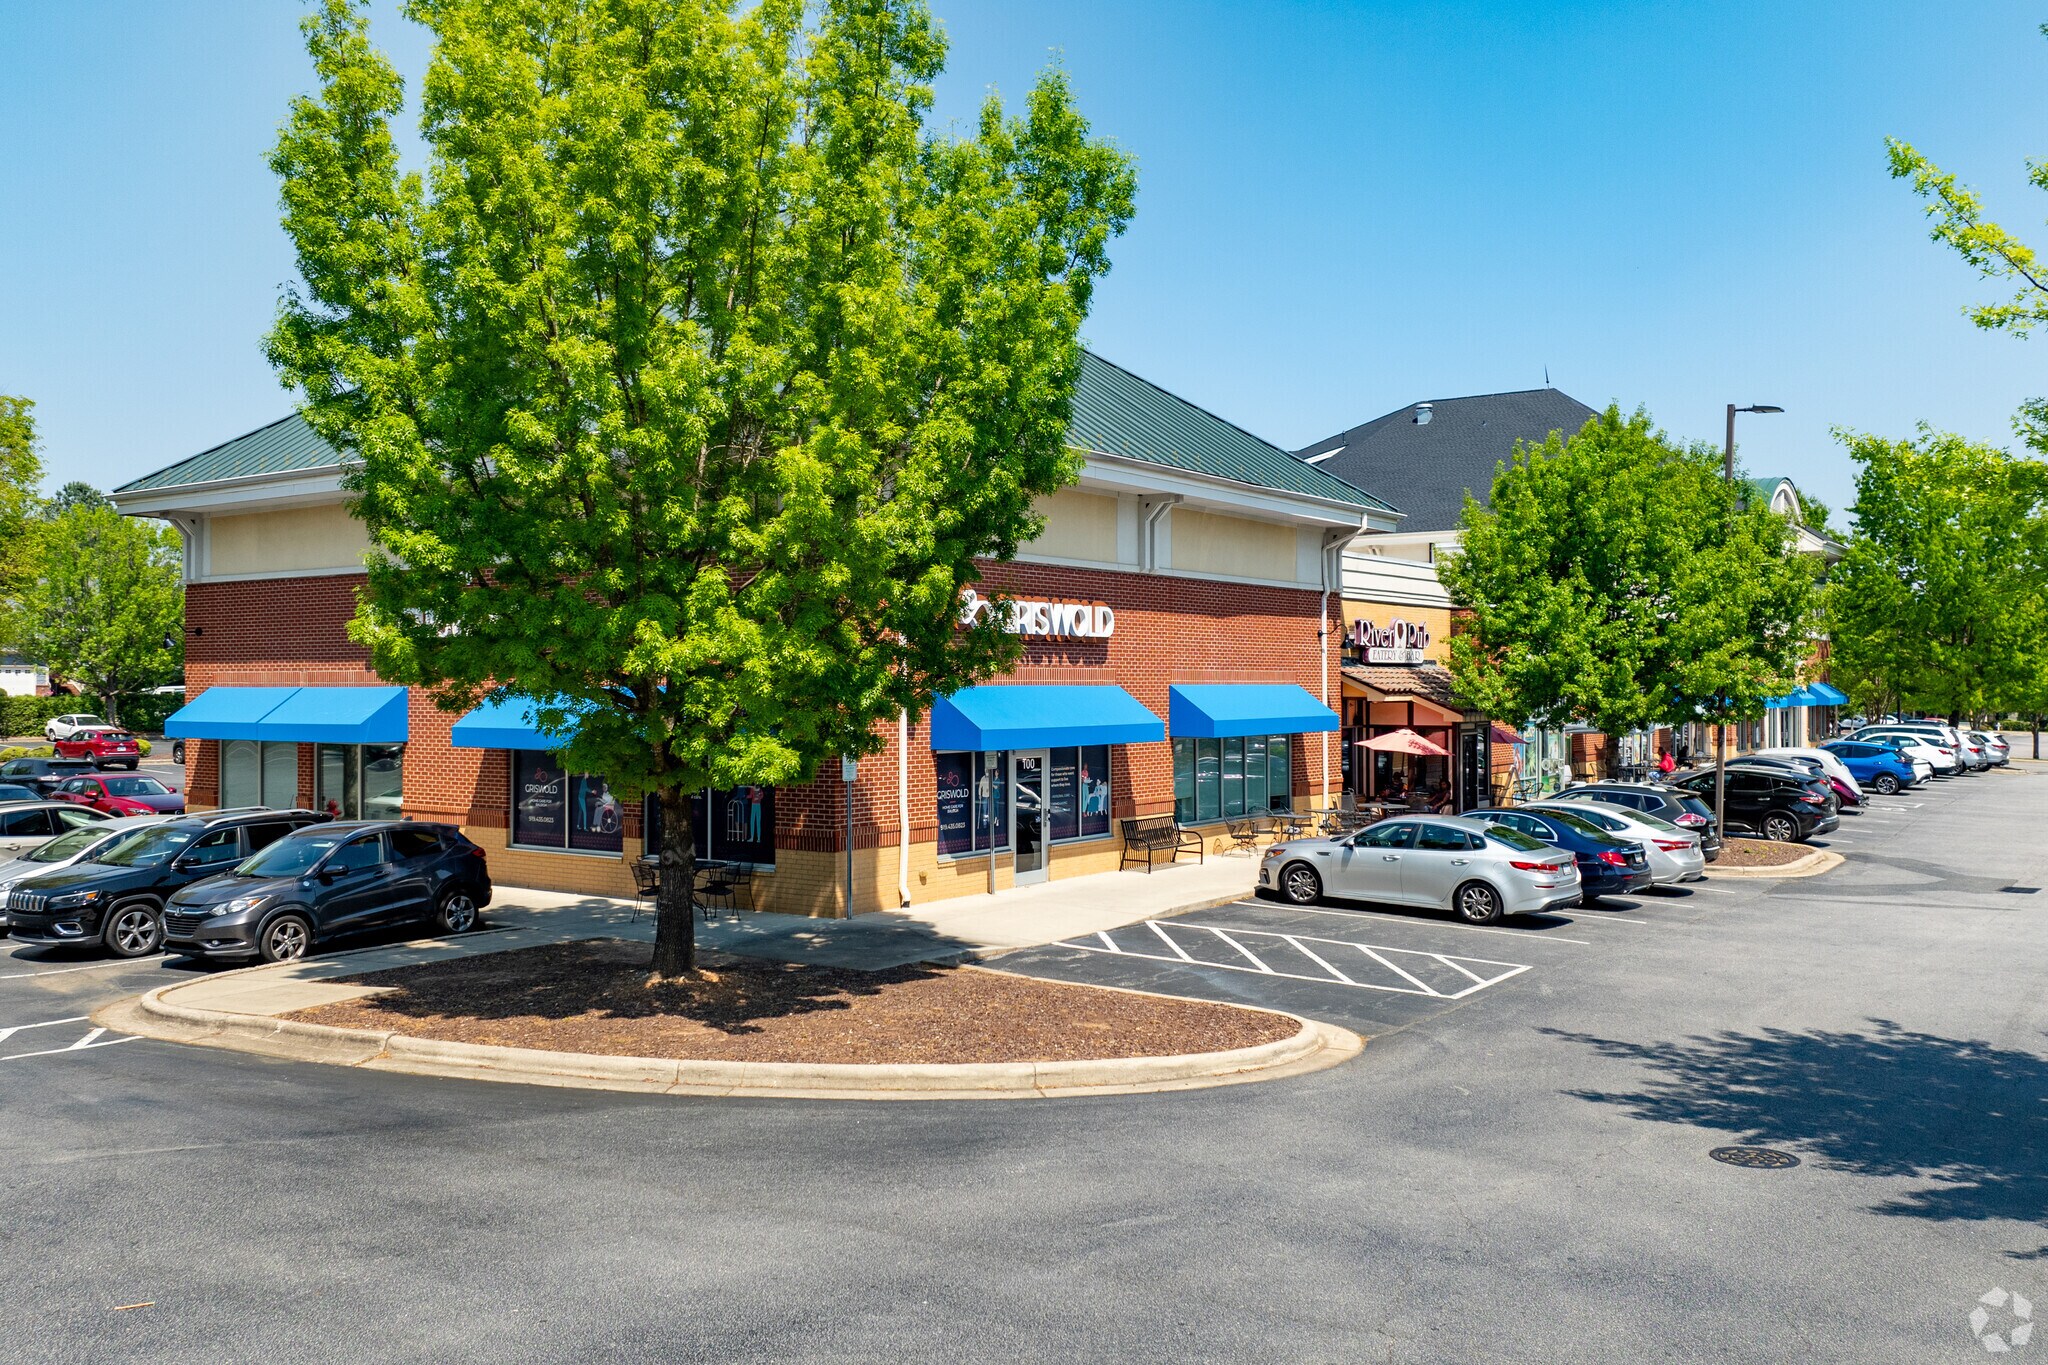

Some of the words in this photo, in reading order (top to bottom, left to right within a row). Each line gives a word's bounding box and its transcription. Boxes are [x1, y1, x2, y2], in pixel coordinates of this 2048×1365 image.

[1357, 619, 1394, 648] River
[1406, 621, 1431, 649] Pub
[1372, 649, 1396, 661] EATERY
[1398, 649, 1405, 661] &
[1406, 650, 1421, 662] BAR
[1022, 758, 1035, 770] 100
[525, 784, 557, 794] GRISWOLD
[937, 788, 970, 800] GRISWOLD
